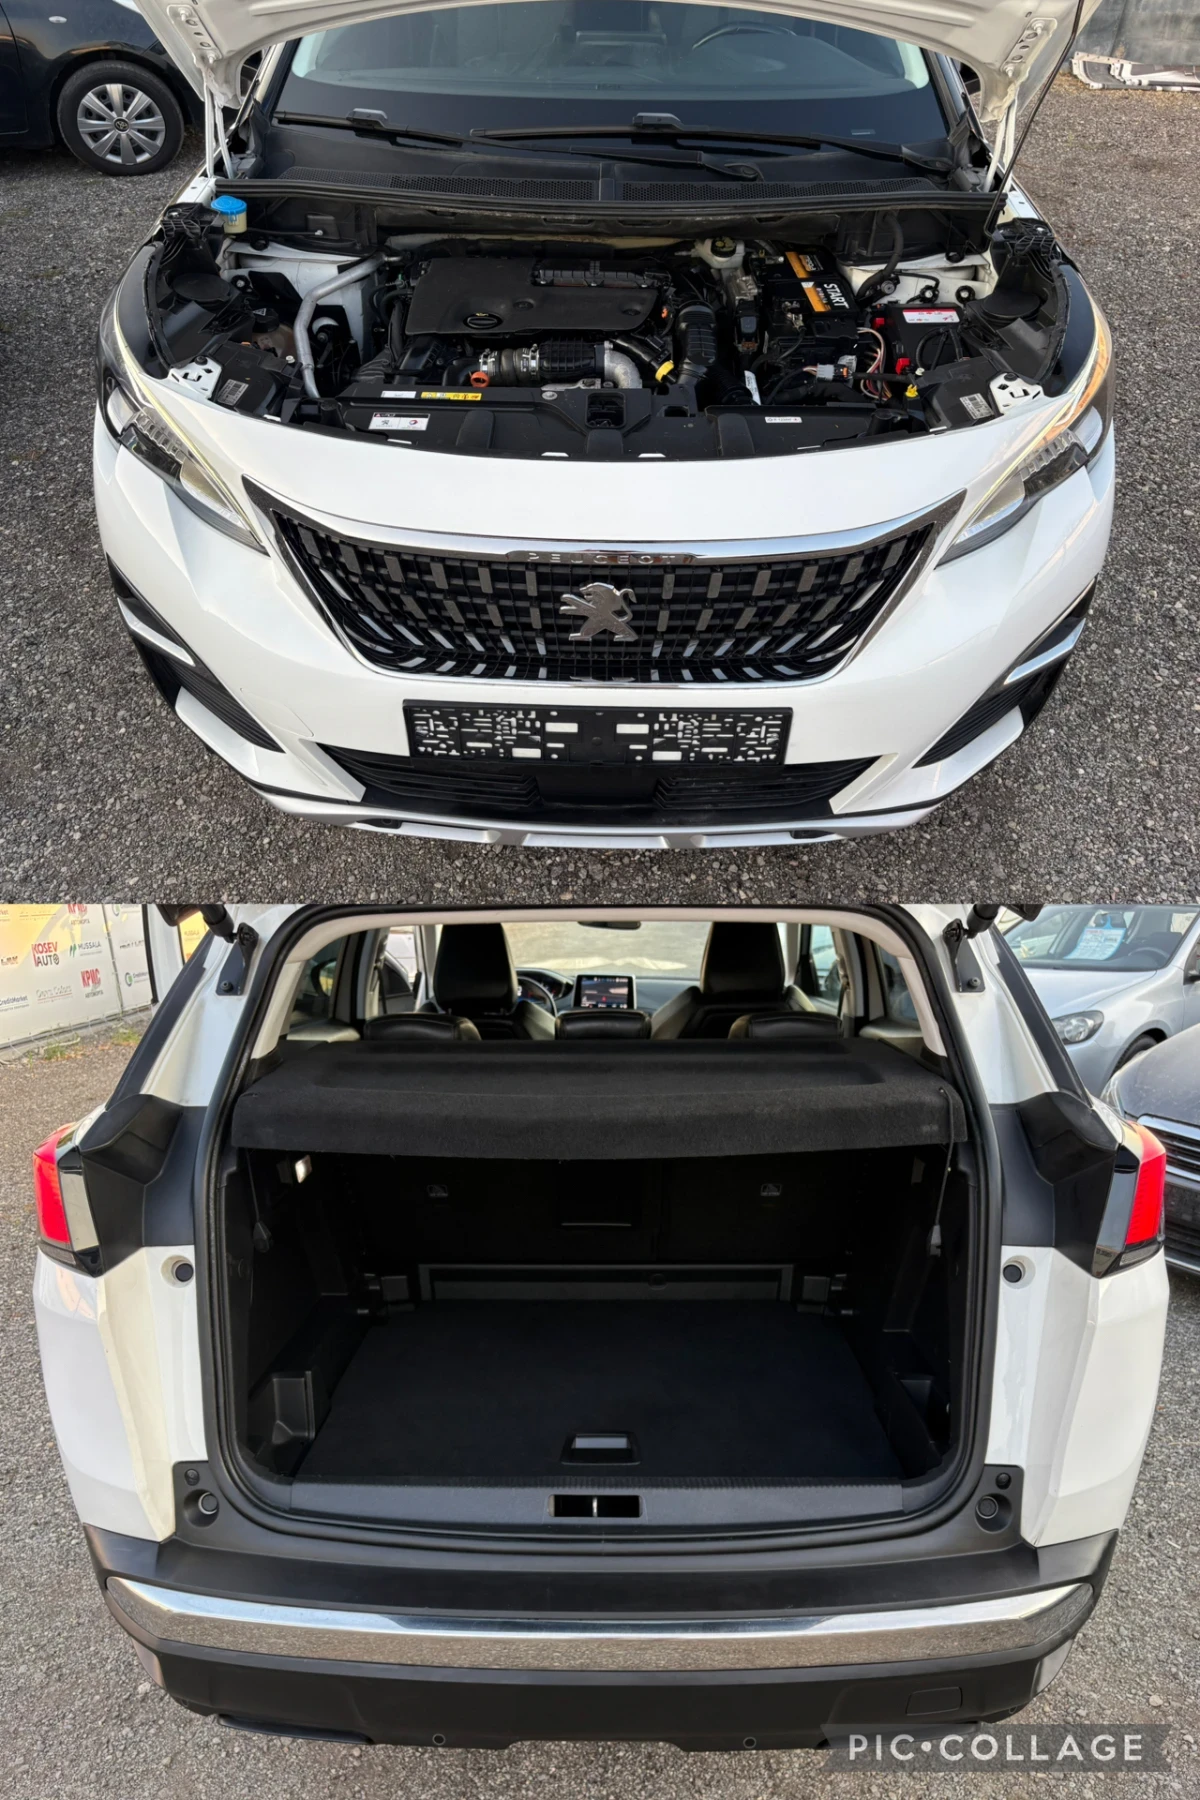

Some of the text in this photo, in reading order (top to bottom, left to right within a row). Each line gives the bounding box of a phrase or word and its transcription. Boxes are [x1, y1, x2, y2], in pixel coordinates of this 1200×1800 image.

[823, 283, 850, 309] START
[31, 941, 58, 954] KOSEV
[77, 941, 102, 950] MUSSALA
[36, 953, 60, 966] AUTO
